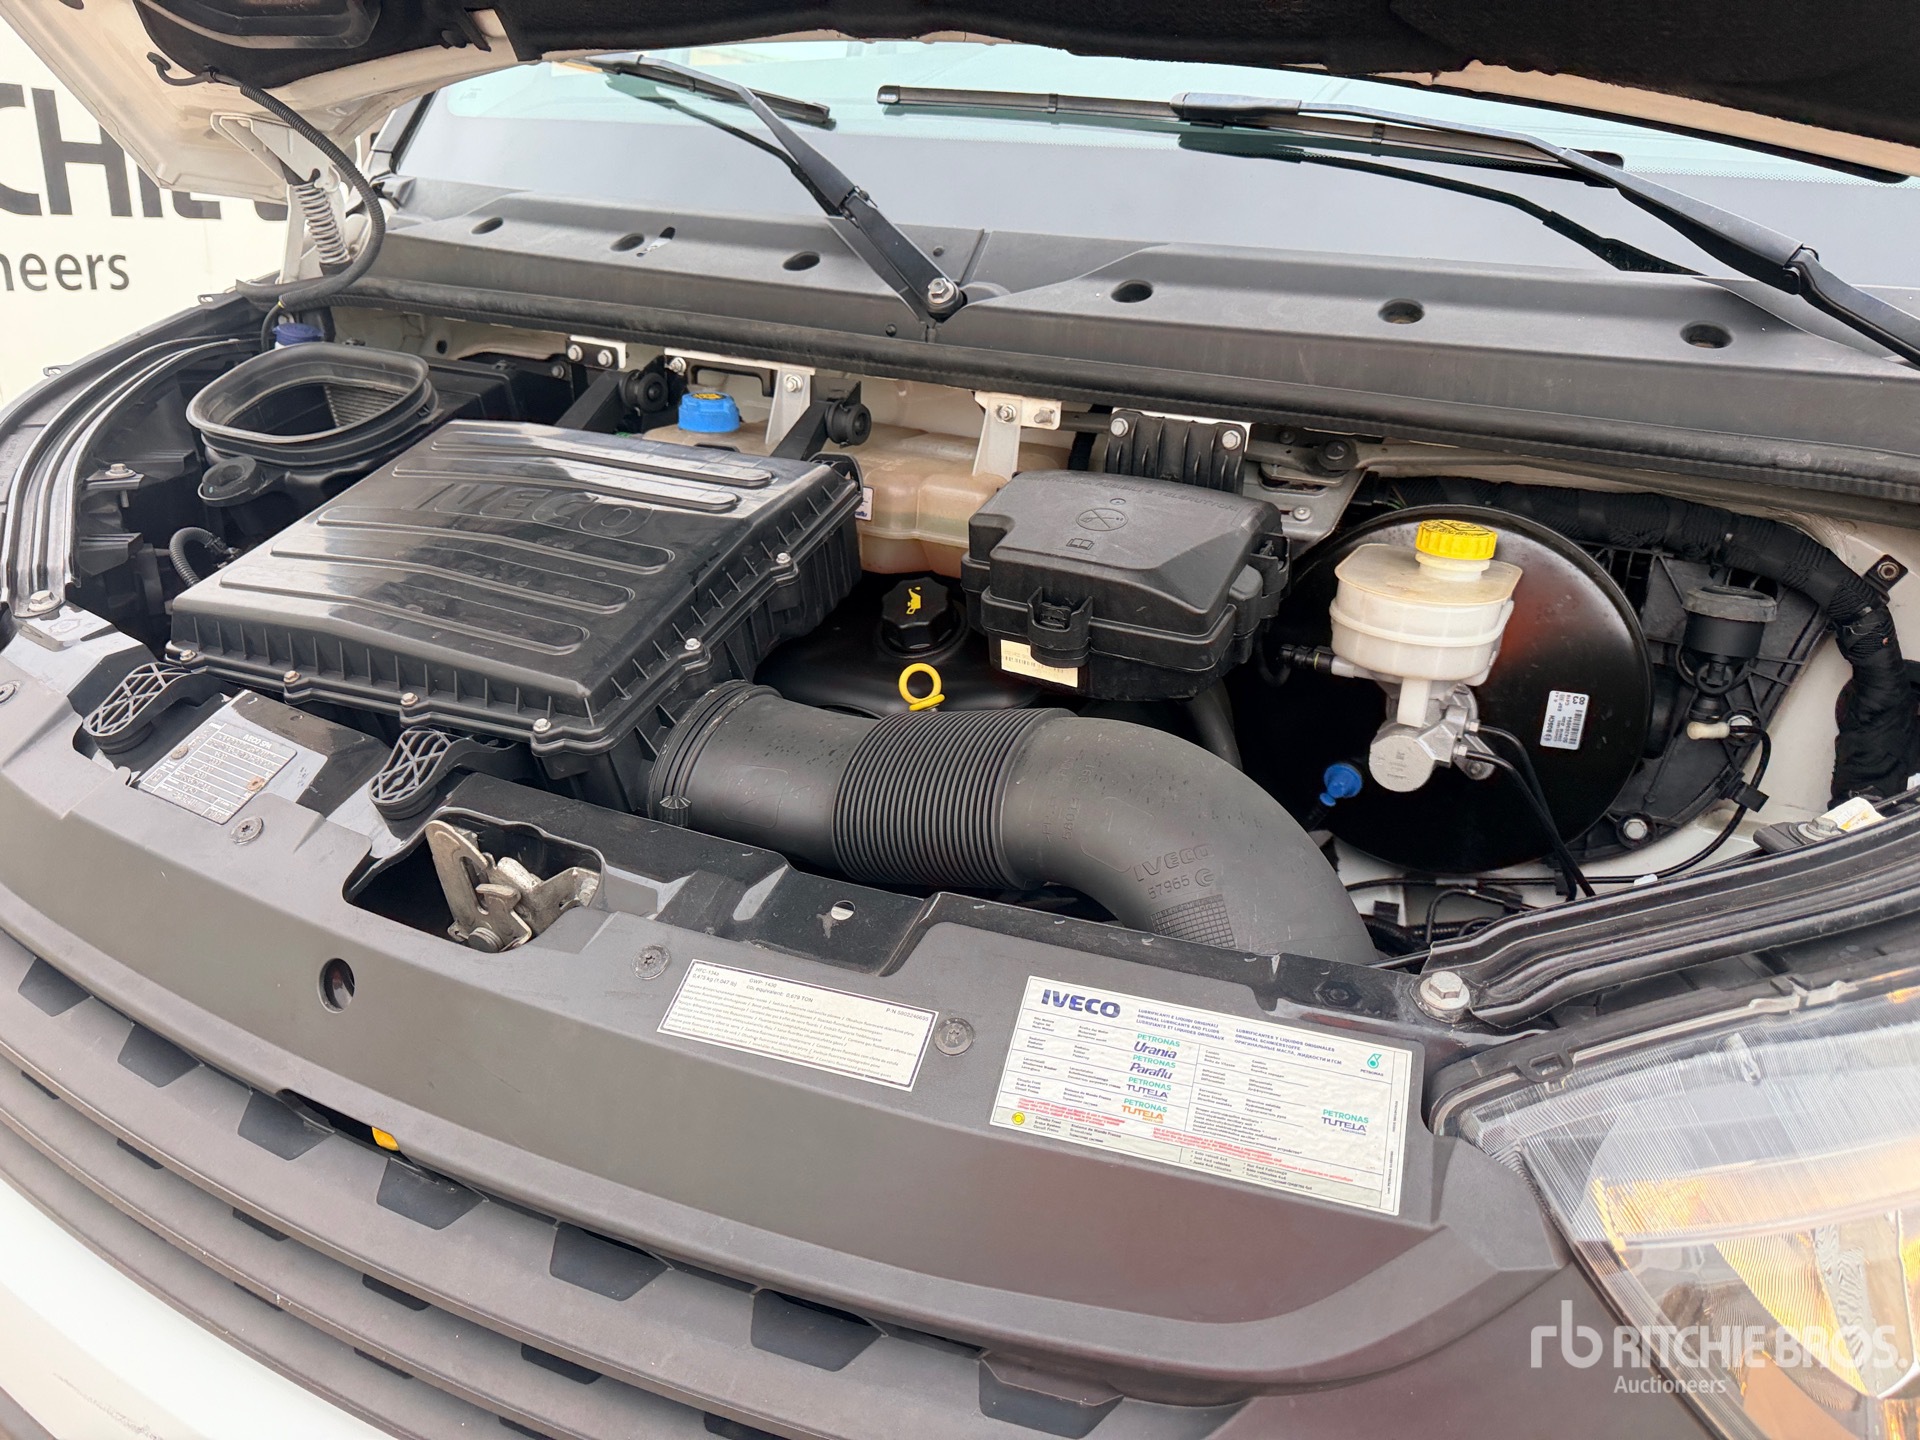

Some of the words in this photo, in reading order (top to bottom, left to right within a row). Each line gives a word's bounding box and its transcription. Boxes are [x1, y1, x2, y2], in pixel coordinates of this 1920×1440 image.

[401, 482, 654, 537] IVECO
[1546, 714, 1555, 732] BOSCH
[1133, 844, 1215, 882] IVECO
[801, 994, 814, 1002] TON
[1040, 988, 1121, 1019] IVECO
[1137, 1033, 1180, 1047] PETRONAS
[1134, 1041, 1178, 1059] Urania
[1132, 1055, 1176, 1069] PETRONAS
[1130, 1062, 1173, 1079] Paraflu
[1126, 1084, 1168, 1098] TUTELA
[1129, 1076, 1172, 1091] PETRONAS
[1122, 1105, 1164, 1120] TUTELA
[1124, 1098, 1168, 1113] PETRONAS
[1323, 1109, 1369, 1123] PETRONAS
[1321, 1116, 1367, 1132] TUTELA
